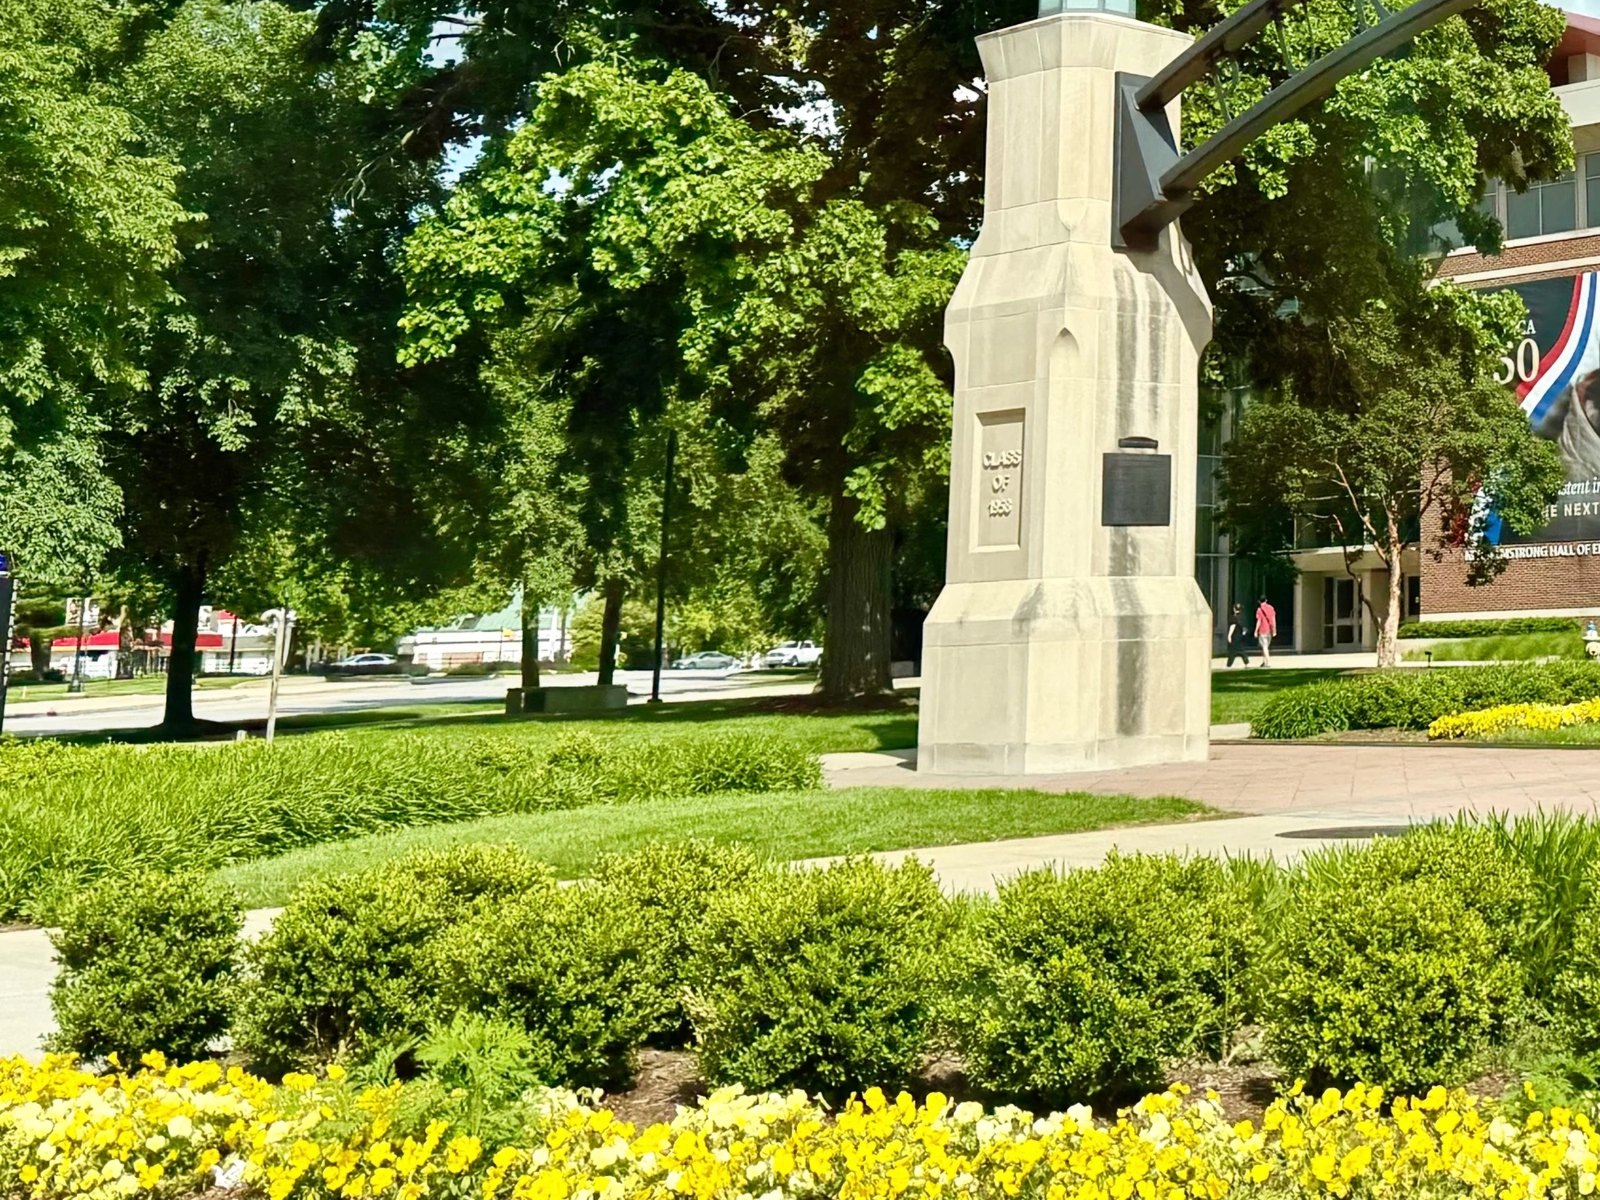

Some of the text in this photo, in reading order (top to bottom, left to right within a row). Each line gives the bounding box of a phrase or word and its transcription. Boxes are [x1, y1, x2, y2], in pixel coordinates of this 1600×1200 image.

[1493, 338, 1540, 385] 50
[983, 449, 1022, 469] CLASS
[992, 474, 1011, 492] OF
[1558, 480, 1591, 496] stent
[1541, 503, 1558, 518] HE
[1564, 502, 1600, 517] NEXT
[1498, 545, 1548, 560] MSTRONG
[1549, 544, 1576, 557] HALL
[1576, 543, 1592, 556] OF
